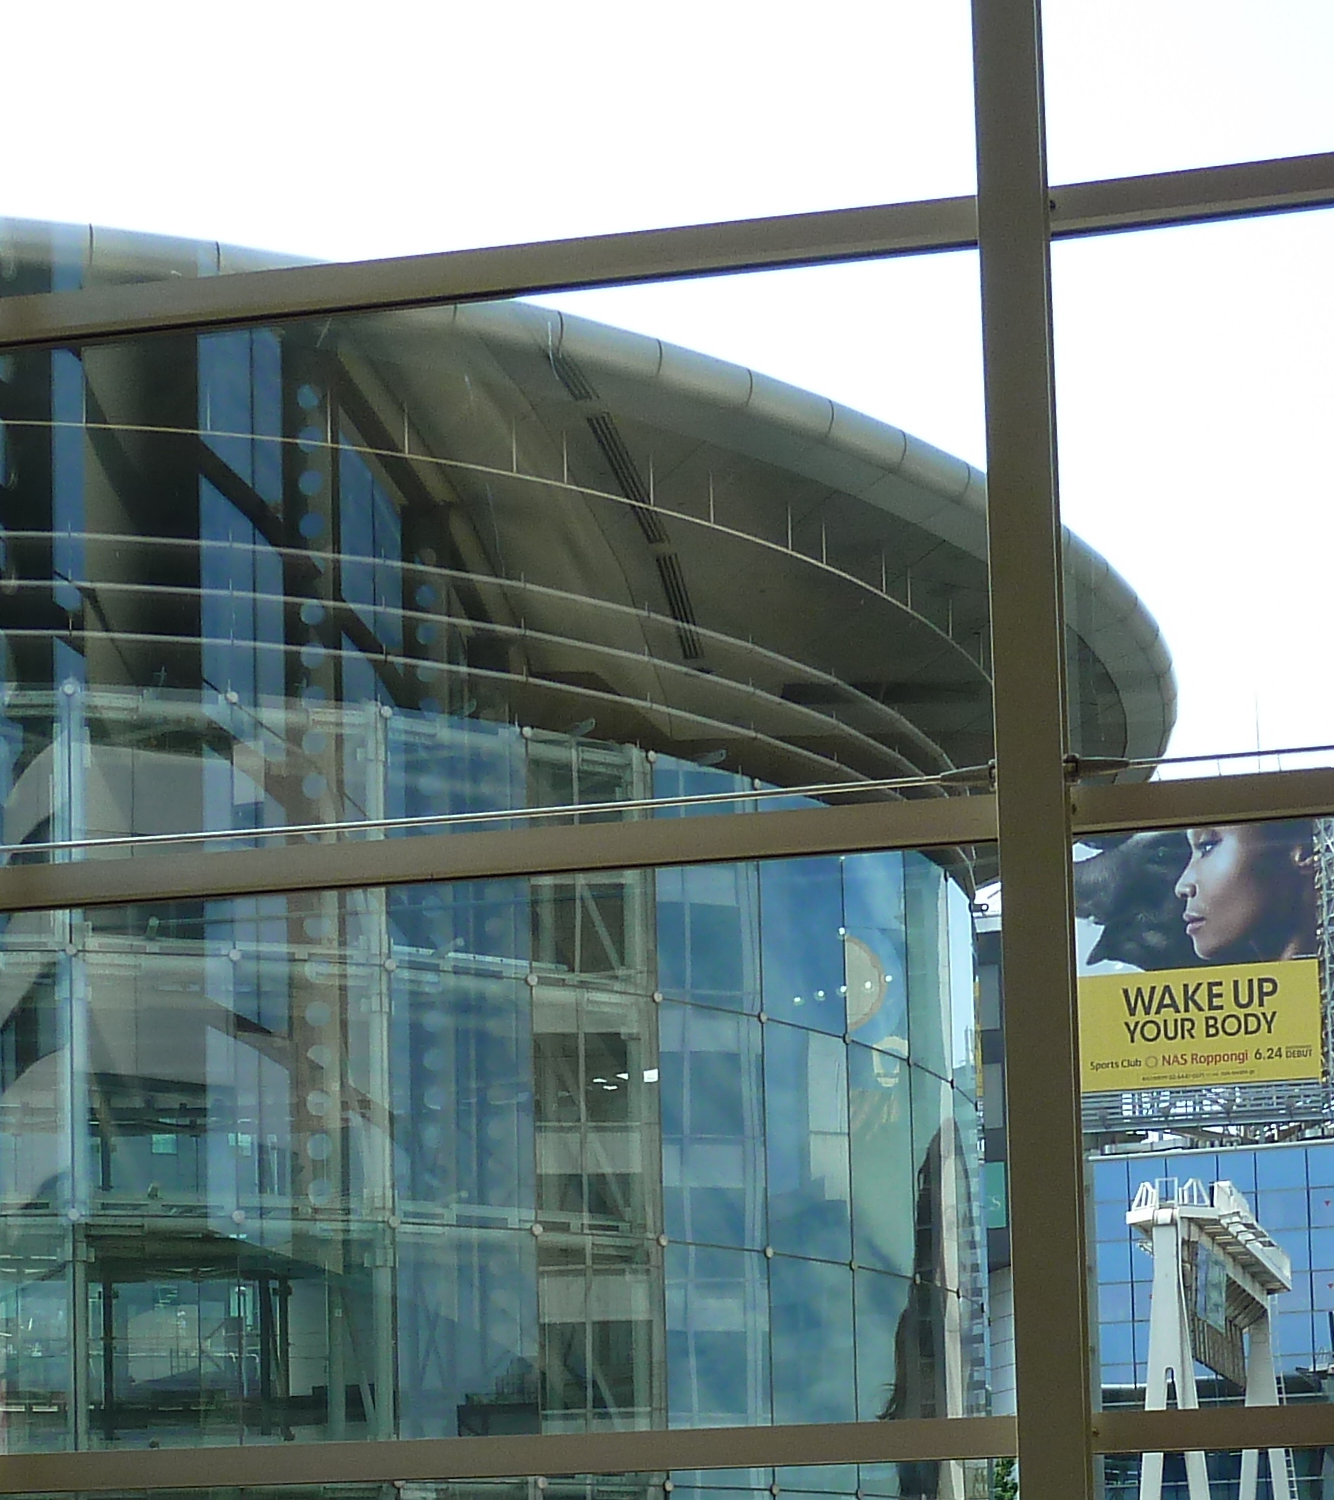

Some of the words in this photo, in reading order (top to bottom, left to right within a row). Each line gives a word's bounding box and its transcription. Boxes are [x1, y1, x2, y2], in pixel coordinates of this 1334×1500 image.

[1122, 980, 1224, 1017] WAKE
[1232, 977, 1279, 1010] UP
[1124, 1018, 1196, 1044] YOUR
[1205, 1011, 1278, 1039] BODY
[1090, 1059, 1120, 1071] Sports
[1121, 1057, 1142, 1068] Club
[1161, 1053, 1188, 1067] NAS
[1190, 1049, 1249, 1066] Roppongi
[1254, 1047, 1283, 1060] 6.24
[1285, 1048, 1313, 1059] DEBUT
